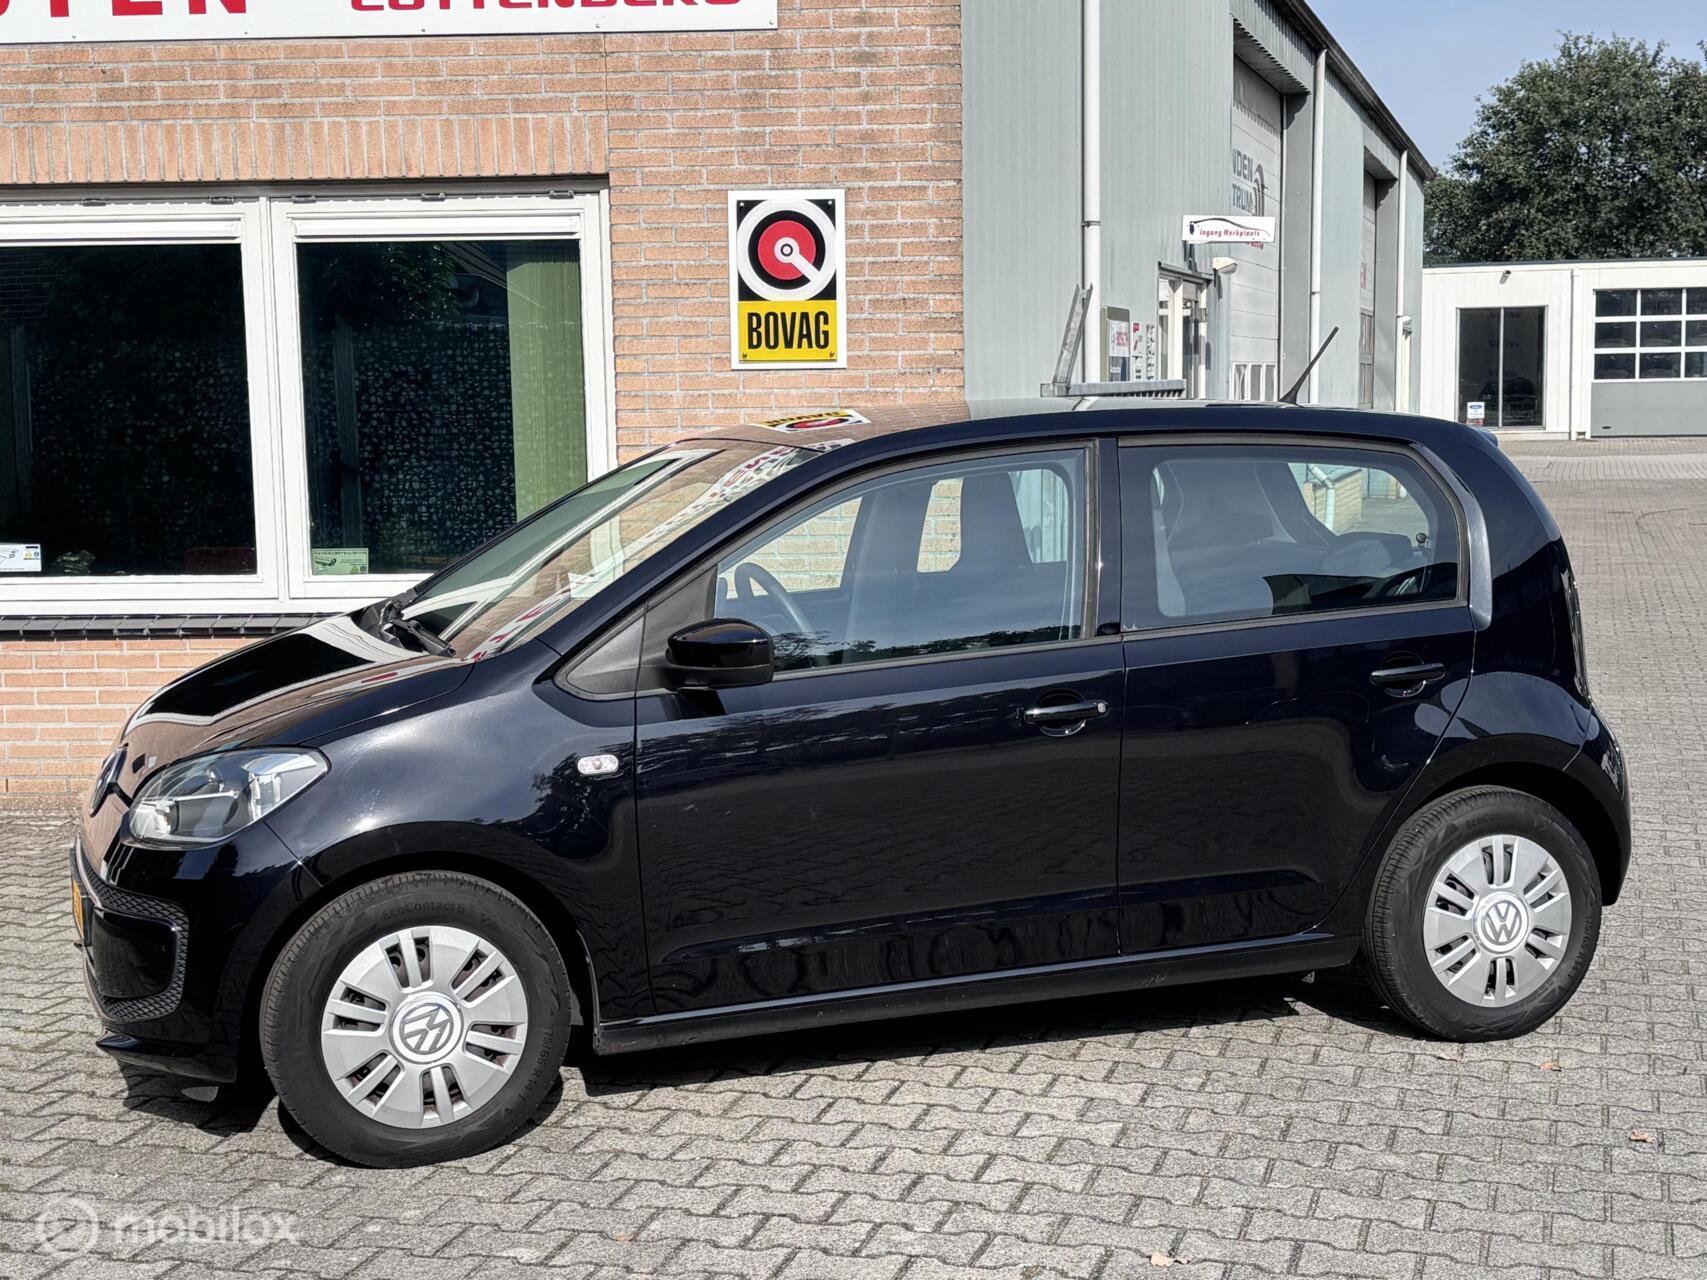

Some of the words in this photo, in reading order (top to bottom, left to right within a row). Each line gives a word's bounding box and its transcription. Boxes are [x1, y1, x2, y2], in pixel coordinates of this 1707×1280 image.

[1200, 228, 1222, 239] Ingang
[1223, 229, 1260, 238] Werkplaats
[747, 311, 829, 350] BOVAG
[383, 901, 455, 920] EcoContact
[457, 903, 466, 913] 6
[538, 1026, 554, 1065] 175/65
